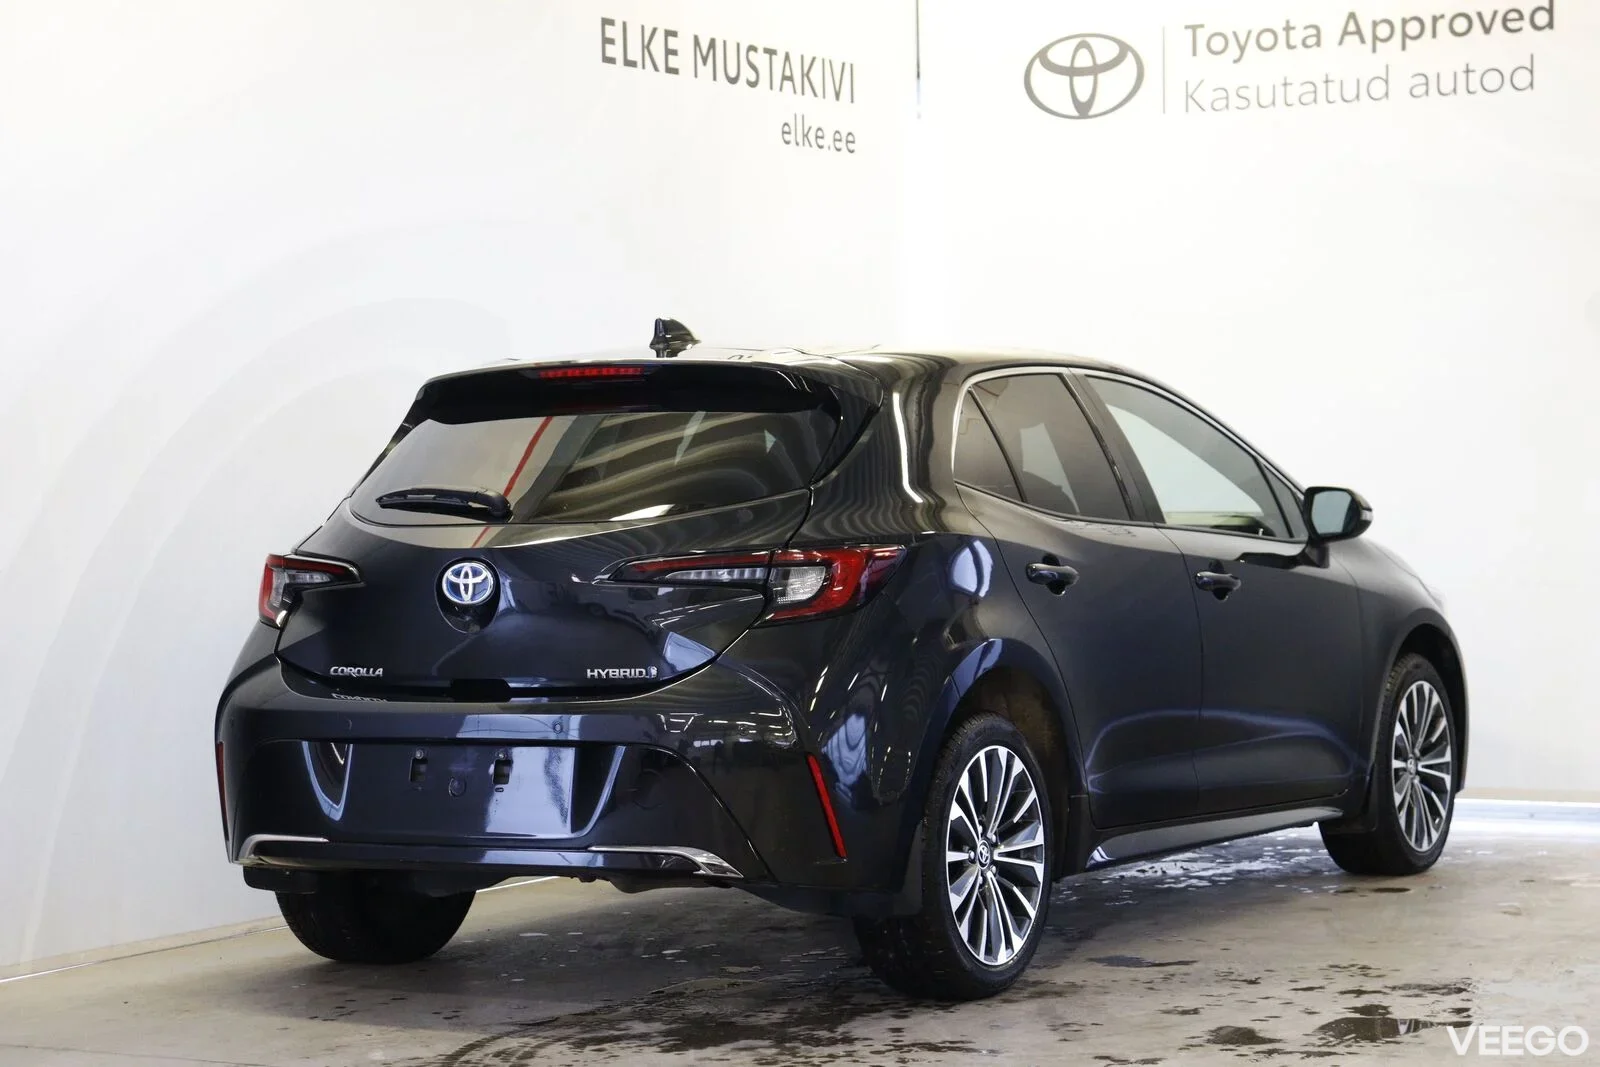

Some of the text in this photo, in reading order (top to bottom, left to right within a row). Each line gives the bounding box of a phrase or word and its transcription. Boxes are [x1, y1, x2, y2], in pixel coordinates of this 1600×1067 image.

[1184, 0, 1554, 64] Toyota Approved
[600, 17, 855, 104] ELKE MUSTAKIVI
[1185, 52, 1535, 113] Kasutatud autod
[781, 113, 856, 154] elke.ee
[329, 666, 384, 678] COROLLA
[586, 667, 647, 679] HYBRID
